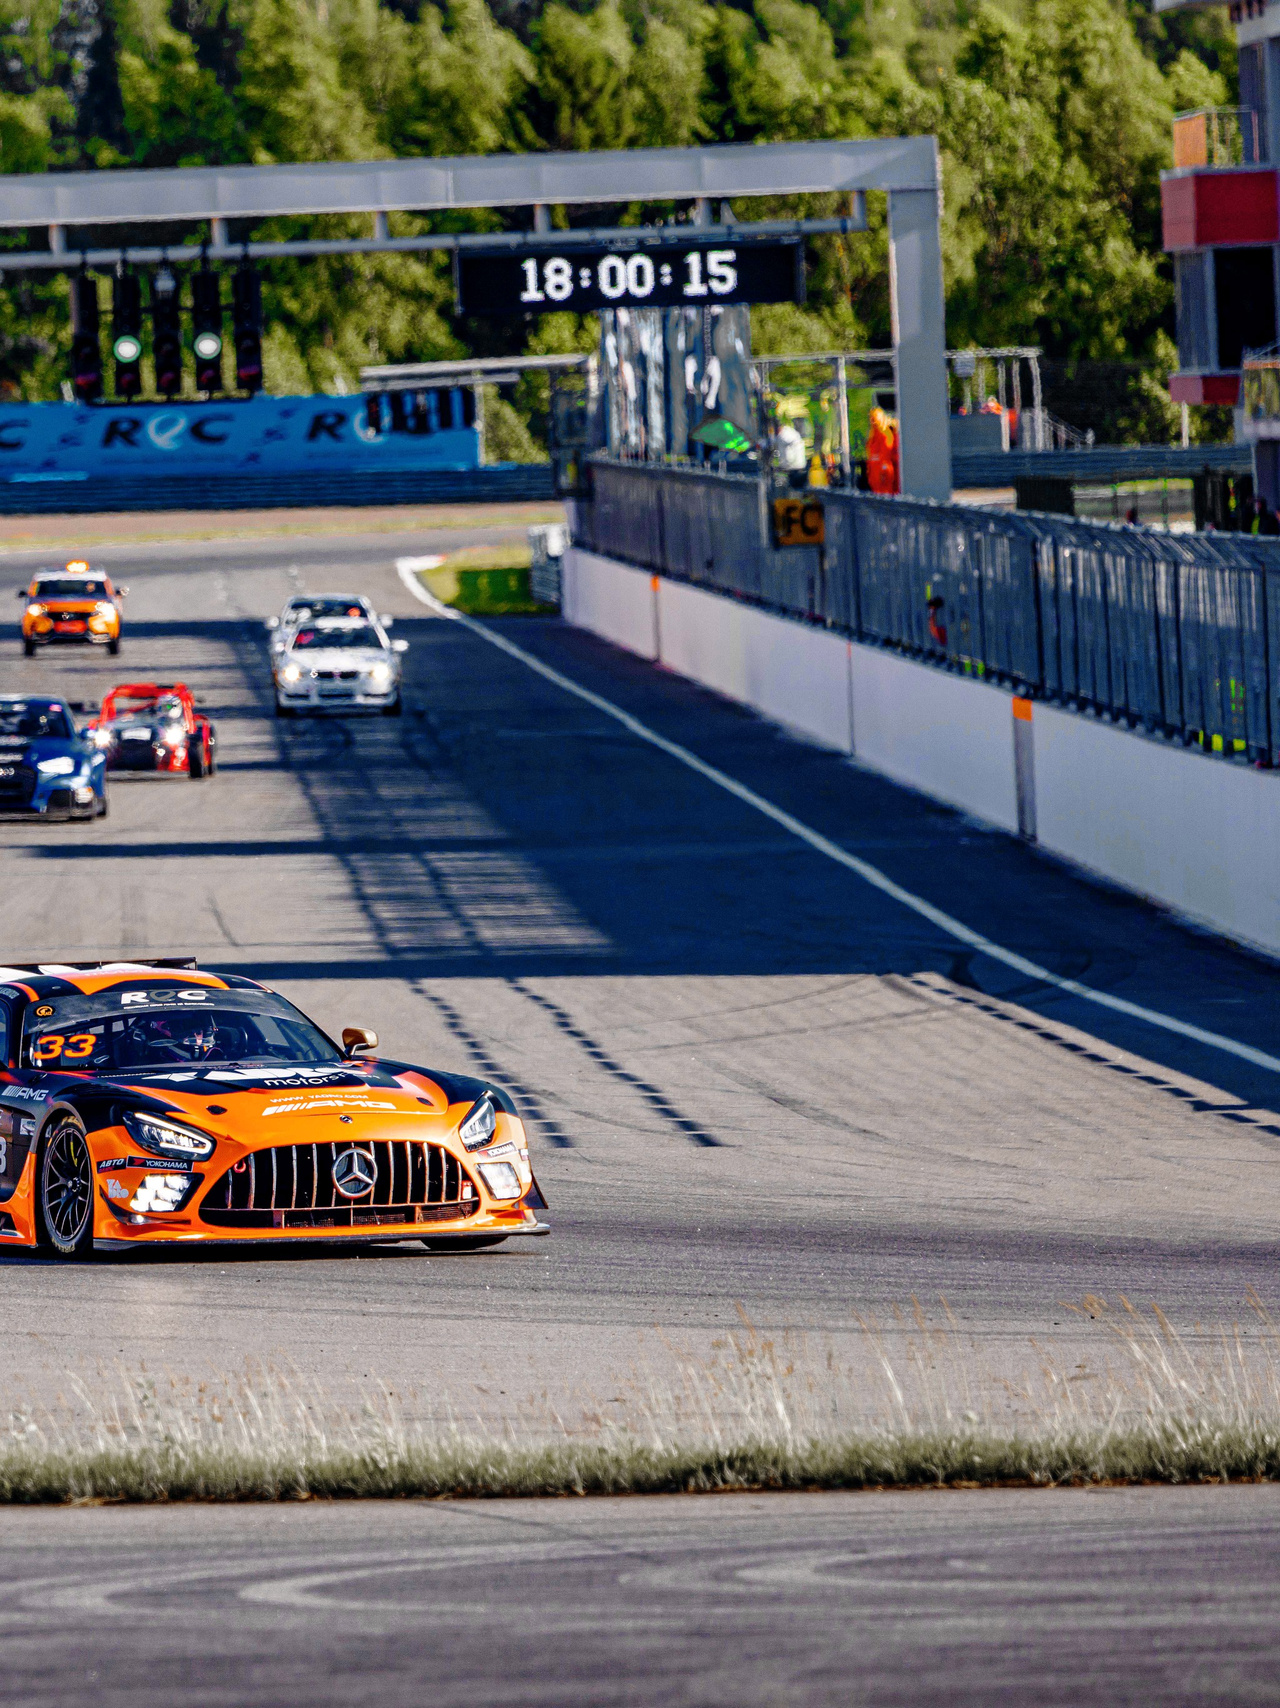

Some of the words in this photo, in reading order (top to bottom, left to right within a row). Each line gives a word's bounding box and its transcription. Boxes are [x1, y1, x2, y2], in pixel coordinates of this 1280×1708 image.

[520, 249, 738, 302] 18:00:15
[34, 1034, 97, 1060] 33
[146, 1160, 188, 1169] YOKOHAMA
